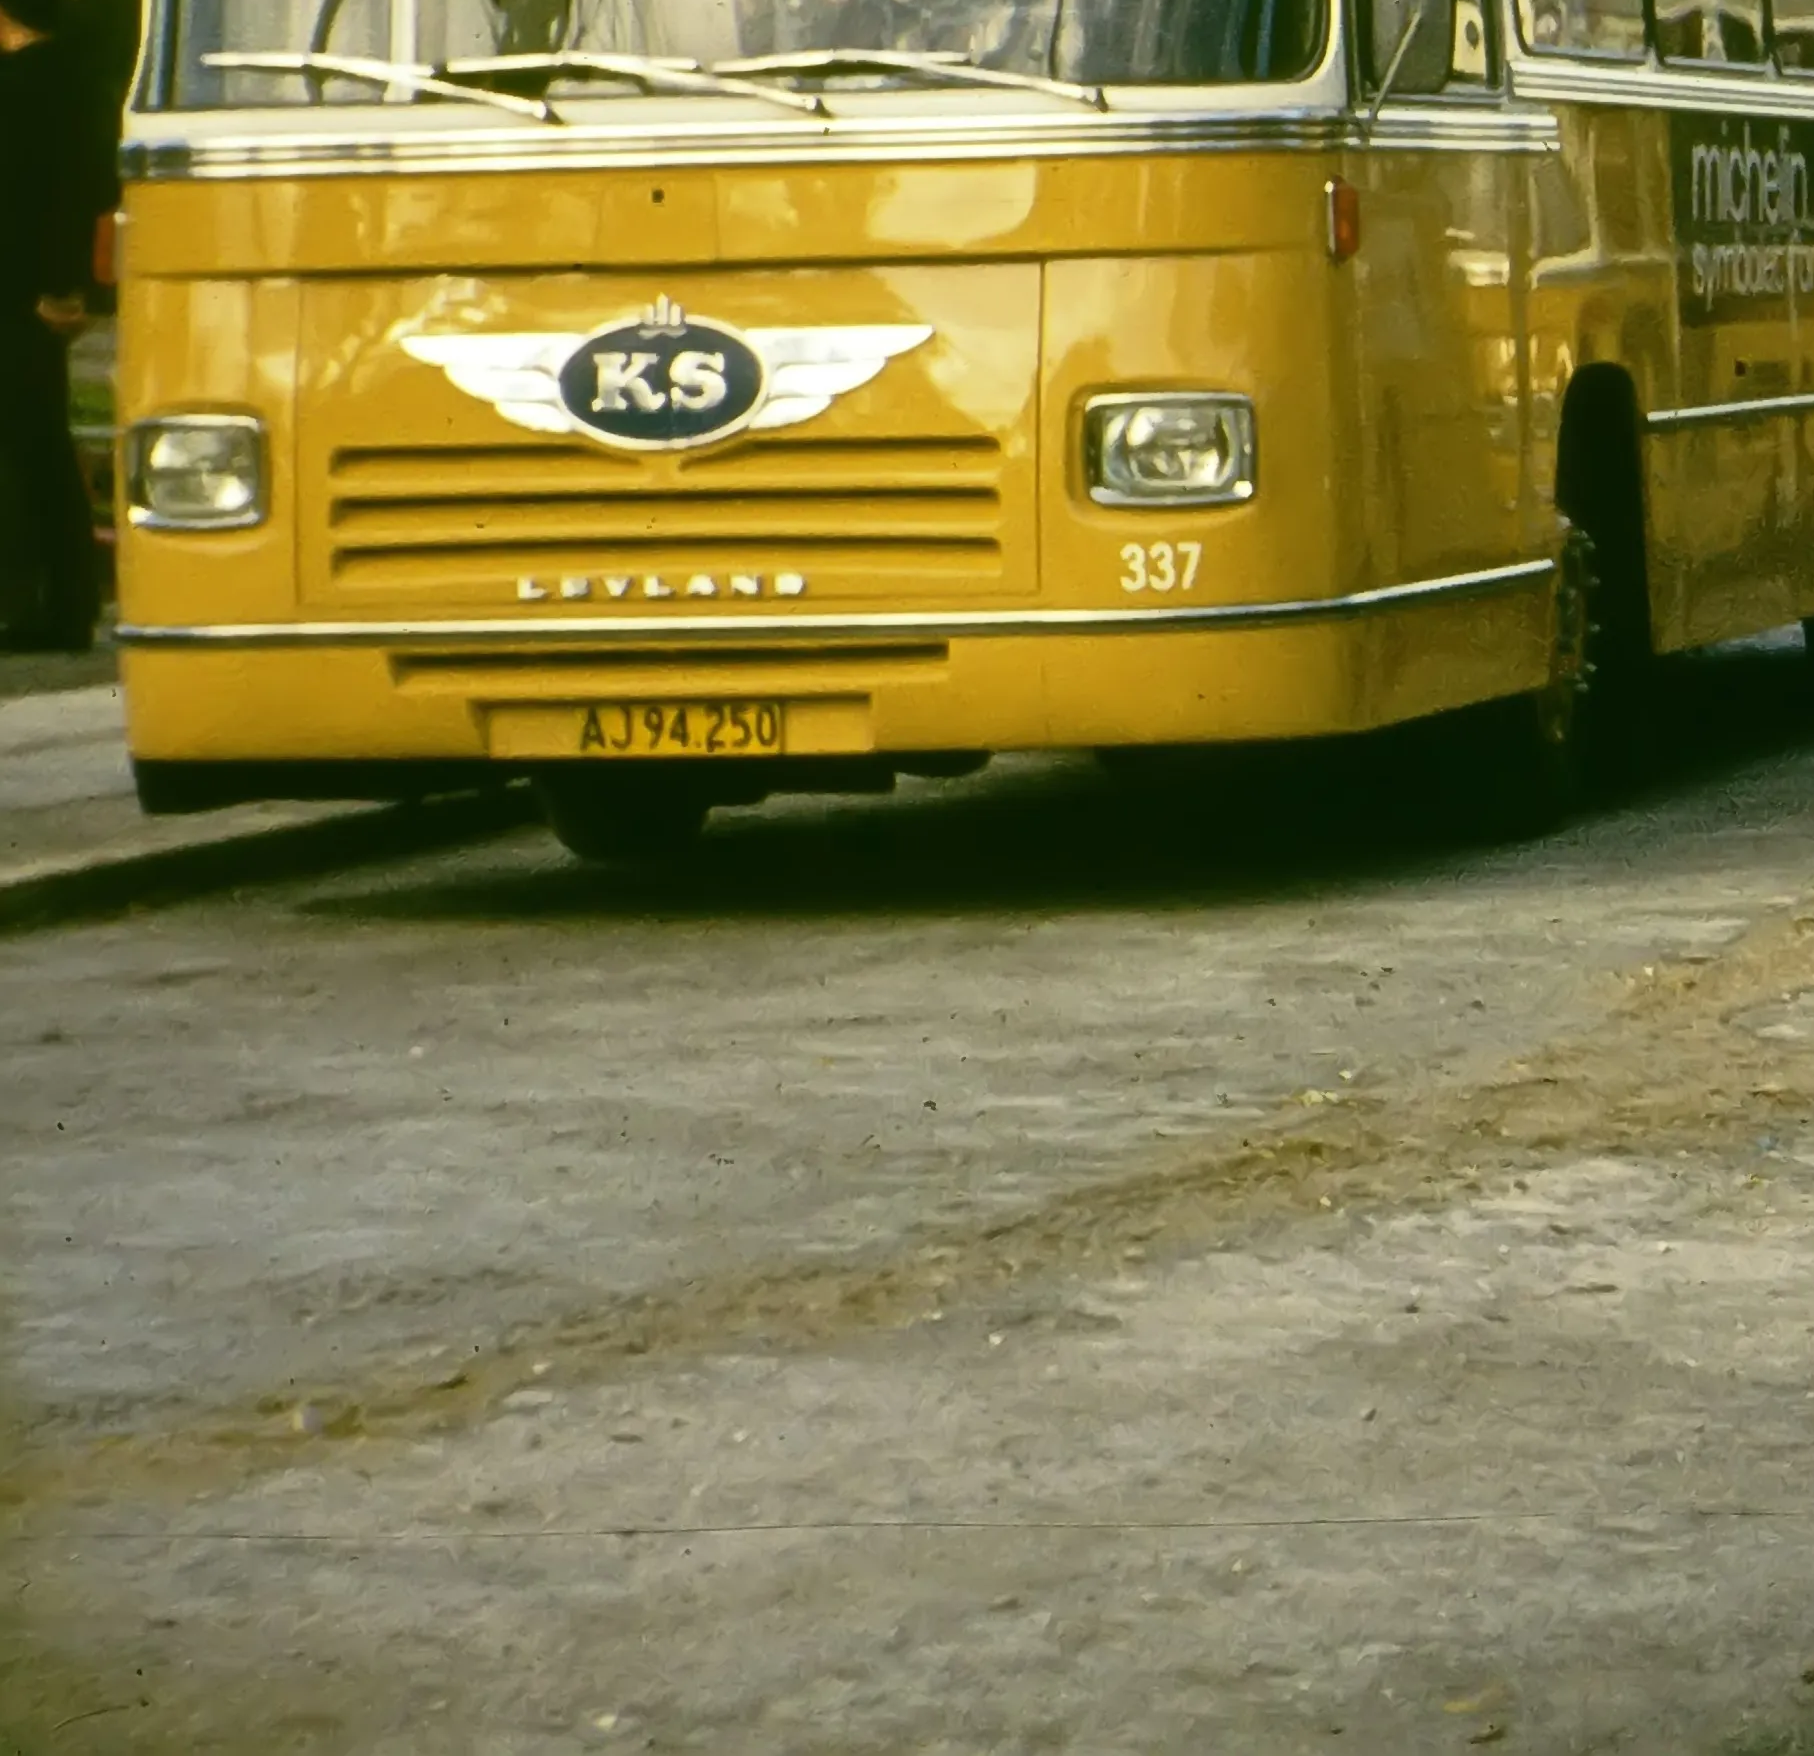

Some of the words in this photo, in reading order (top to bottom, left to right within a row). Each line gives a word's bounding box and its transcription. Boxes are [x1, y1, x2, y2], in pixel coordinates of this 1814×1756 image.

[591, 351, 727, 412] KS
[516, 572, 804, 599] LEYLAND
[1120, 541, 1201, 592] 337
